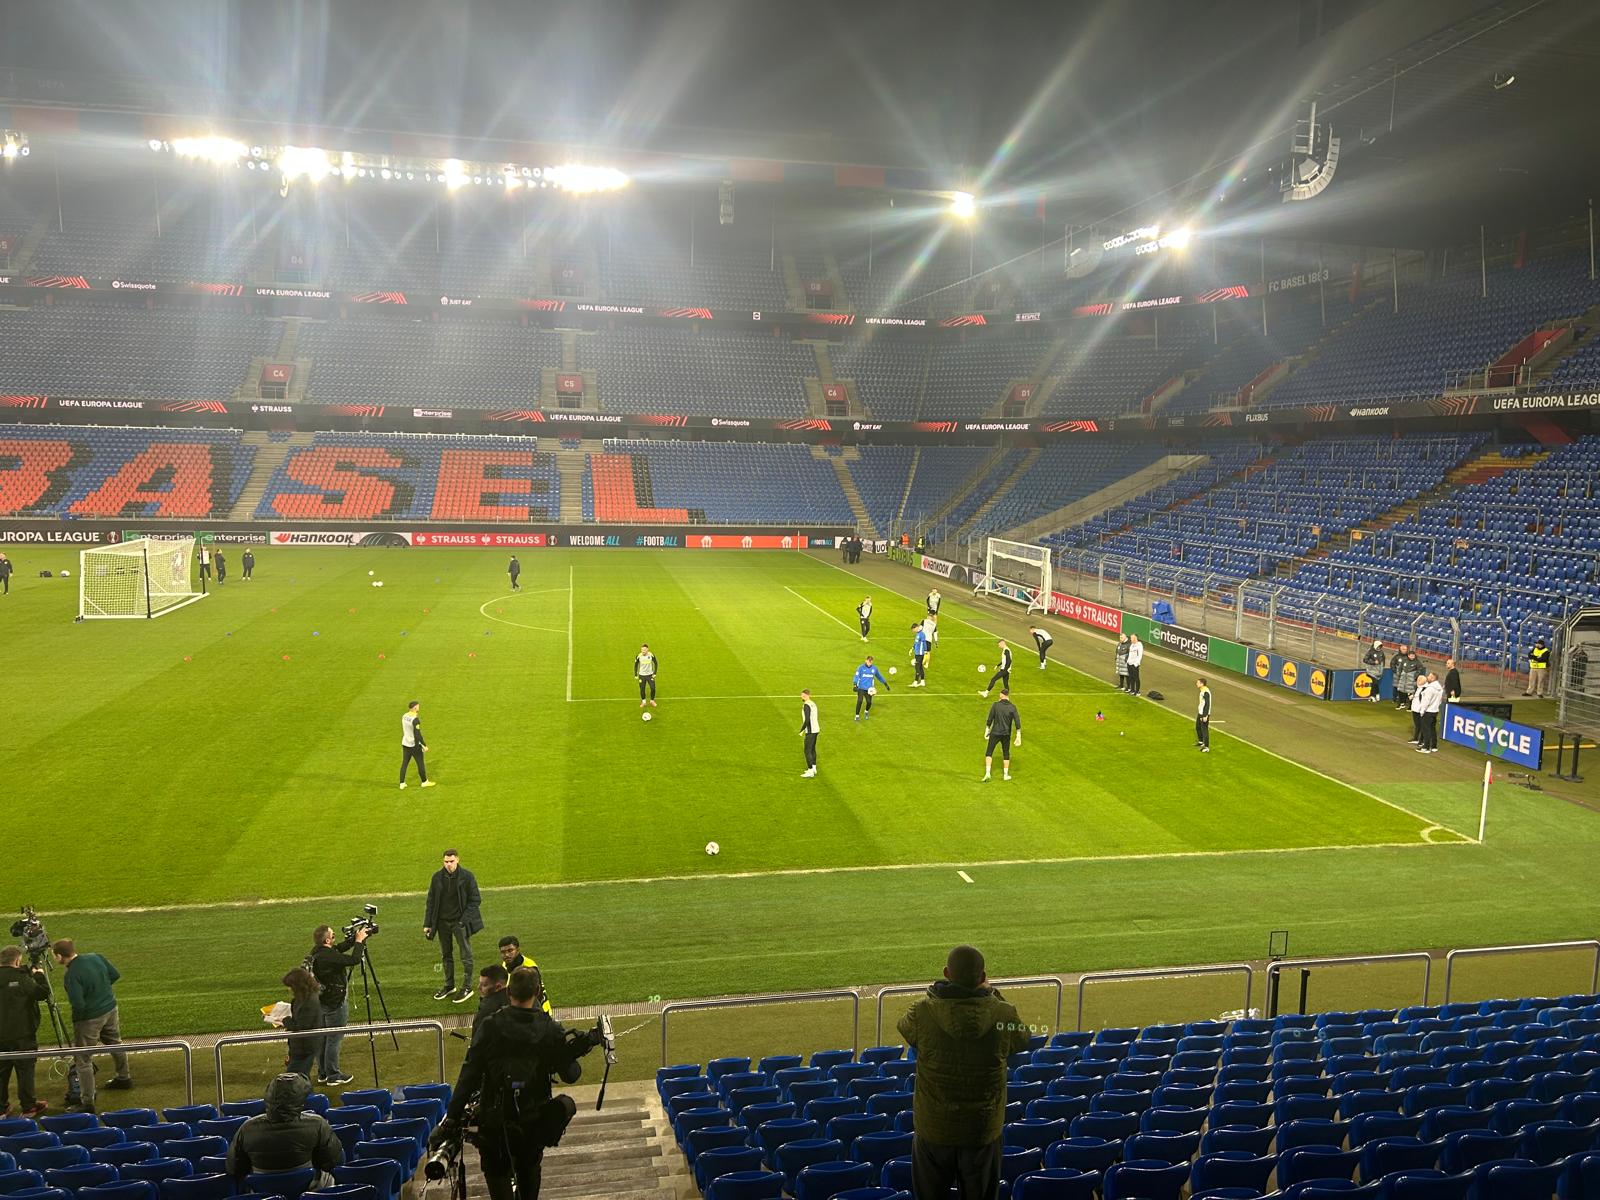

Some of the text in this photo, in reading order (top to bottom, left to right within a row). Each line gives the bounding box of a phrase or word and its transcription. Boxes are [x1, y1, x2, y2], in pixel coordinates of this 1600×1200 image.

[120, 281, 156, 290] Swissquote
[1268, 281, 1279, 293] FC
[1281, 275, 1307, 289] BASEL
[1137, 300, 1158, 308] EUROPA
[1158, 296, 1181, 305] LEAGUE
[564, 380, 574, 388] C5
[828, 389, 837, 397] C6
[1493, 393, 1600, 410] UEFA EUROPA LEAG
[260, 405, 292, 413] STRAUSS
[718, 419, 750, 427] Swissquote
[0, 532, 100, 542] UROPA LEAGUE
[206, 533, 266, 543] enterprise
[431, 535, 540, 544] STRAUSS STRAUSS
[570, 536, 621, 546] WELCOME ALL
[636, 536, 678, 546] #FOOTBALL
[1082, 606, 1118, 628] STRAUSS
[1151, 628, 1208, 654] enterprise
[1452, 715, 1531, 755] RECYCLE
